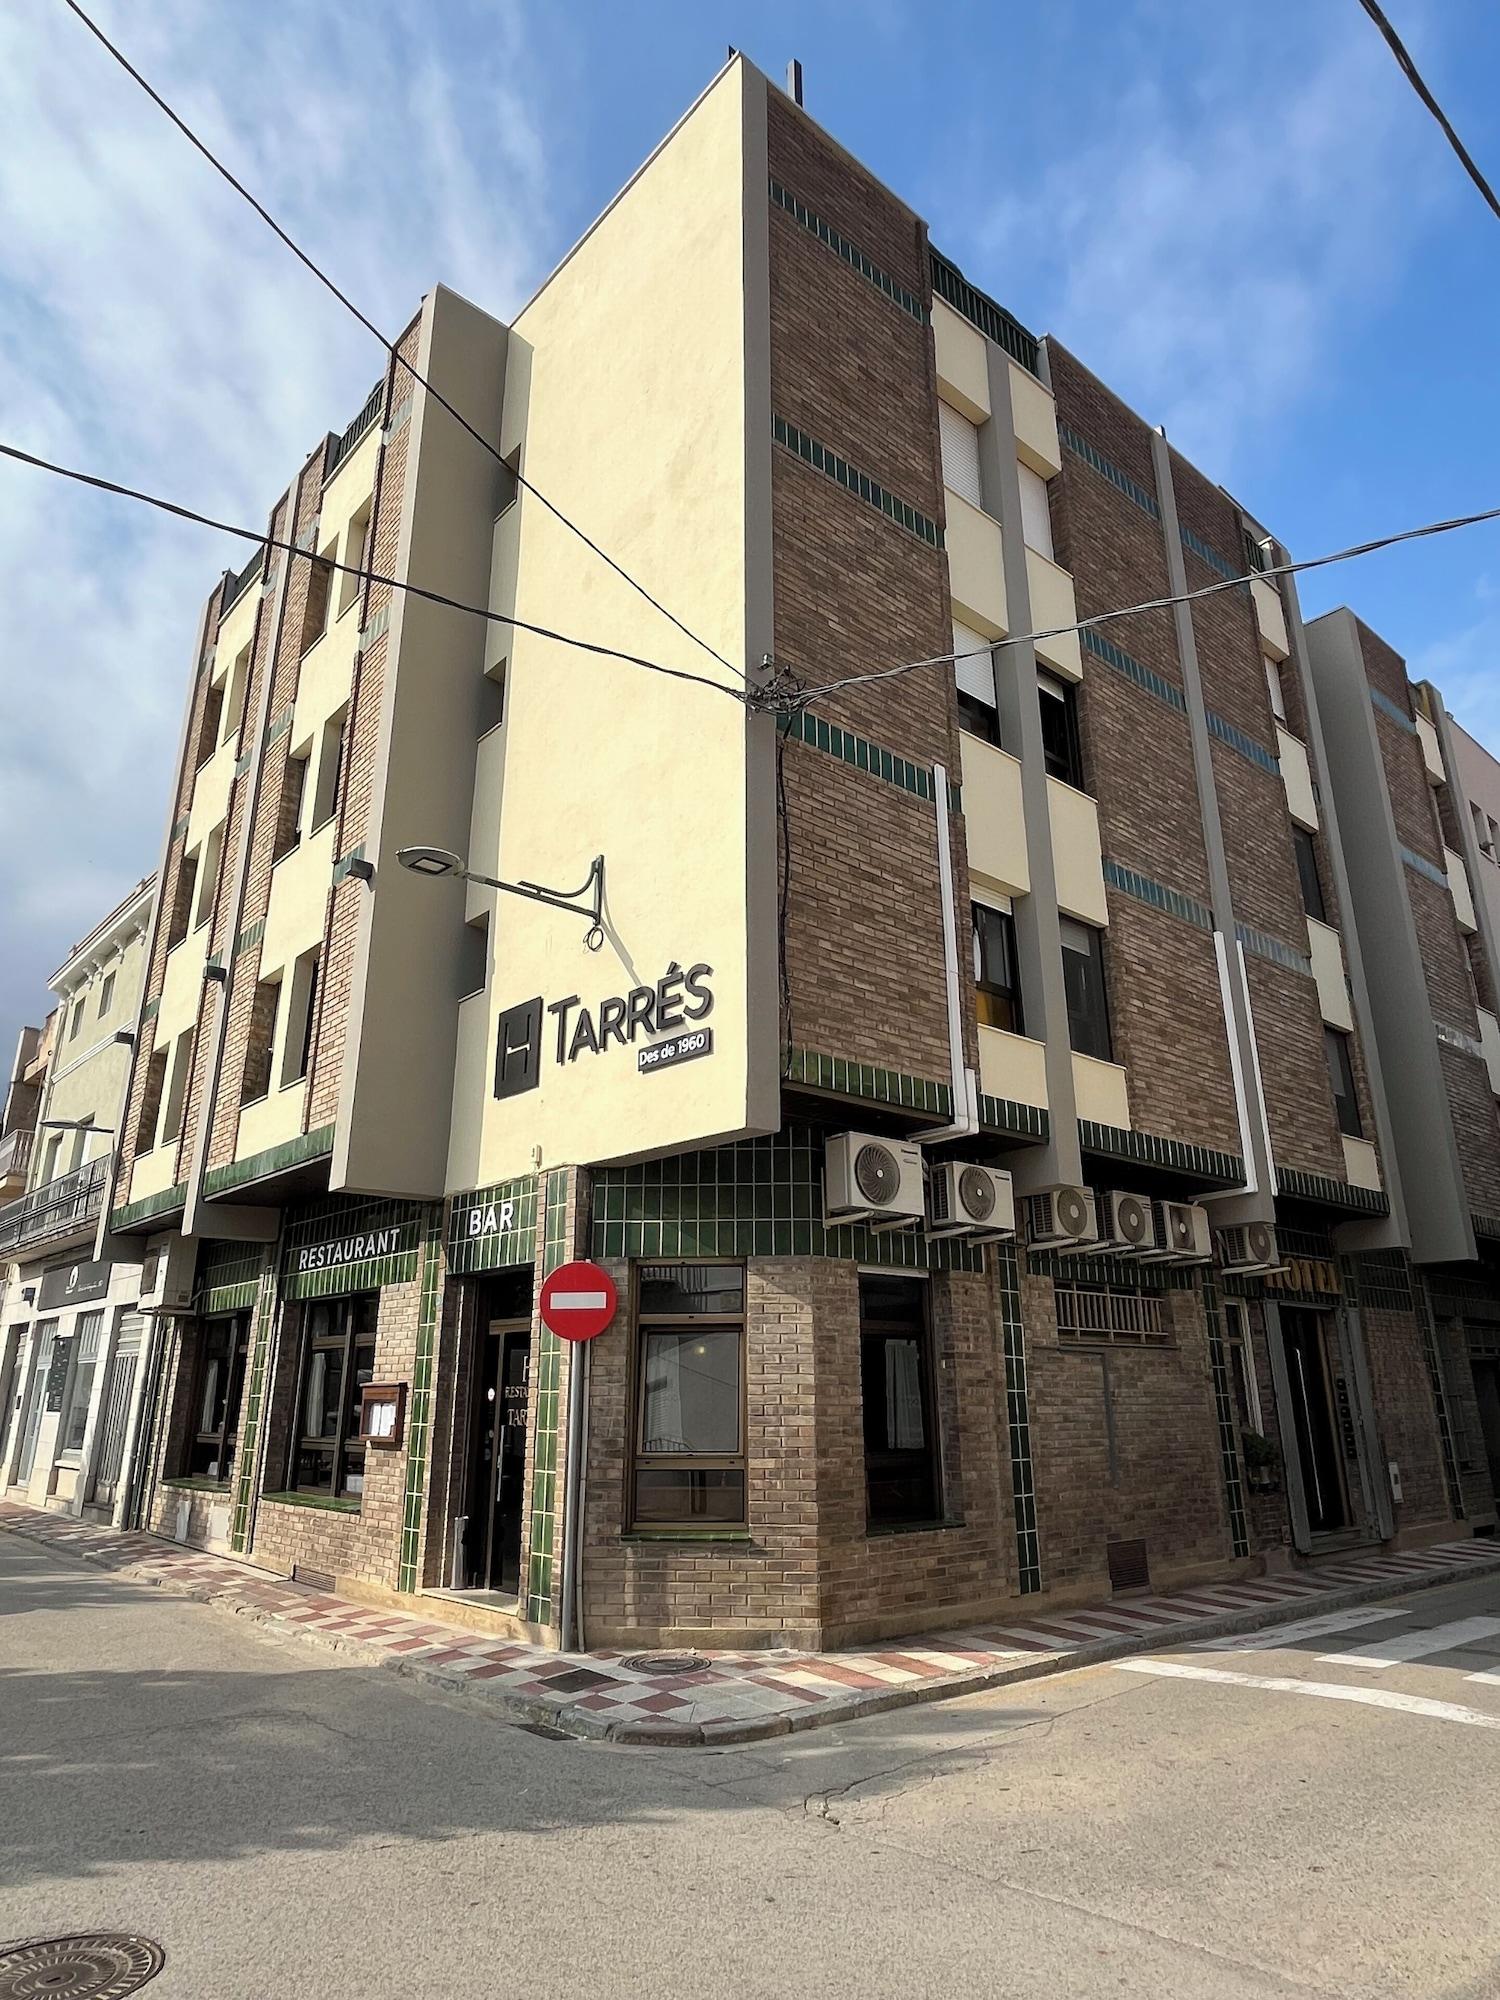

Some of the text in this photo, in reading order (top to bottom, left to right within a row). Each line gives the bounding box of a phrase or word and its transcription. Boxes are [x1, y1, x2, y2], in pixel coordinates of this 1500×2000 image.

[547, 961, 714, 1064] TARRÉS
[639, 1033, 705, 1066] Des de 1960
[469, 1203, 514, 1236] BAR
[299, 1228, 400, 1271] RESTAURANT
[504, 1386, 529, 1399] RESTA
[506, 1408, 528, 1427] TAR
